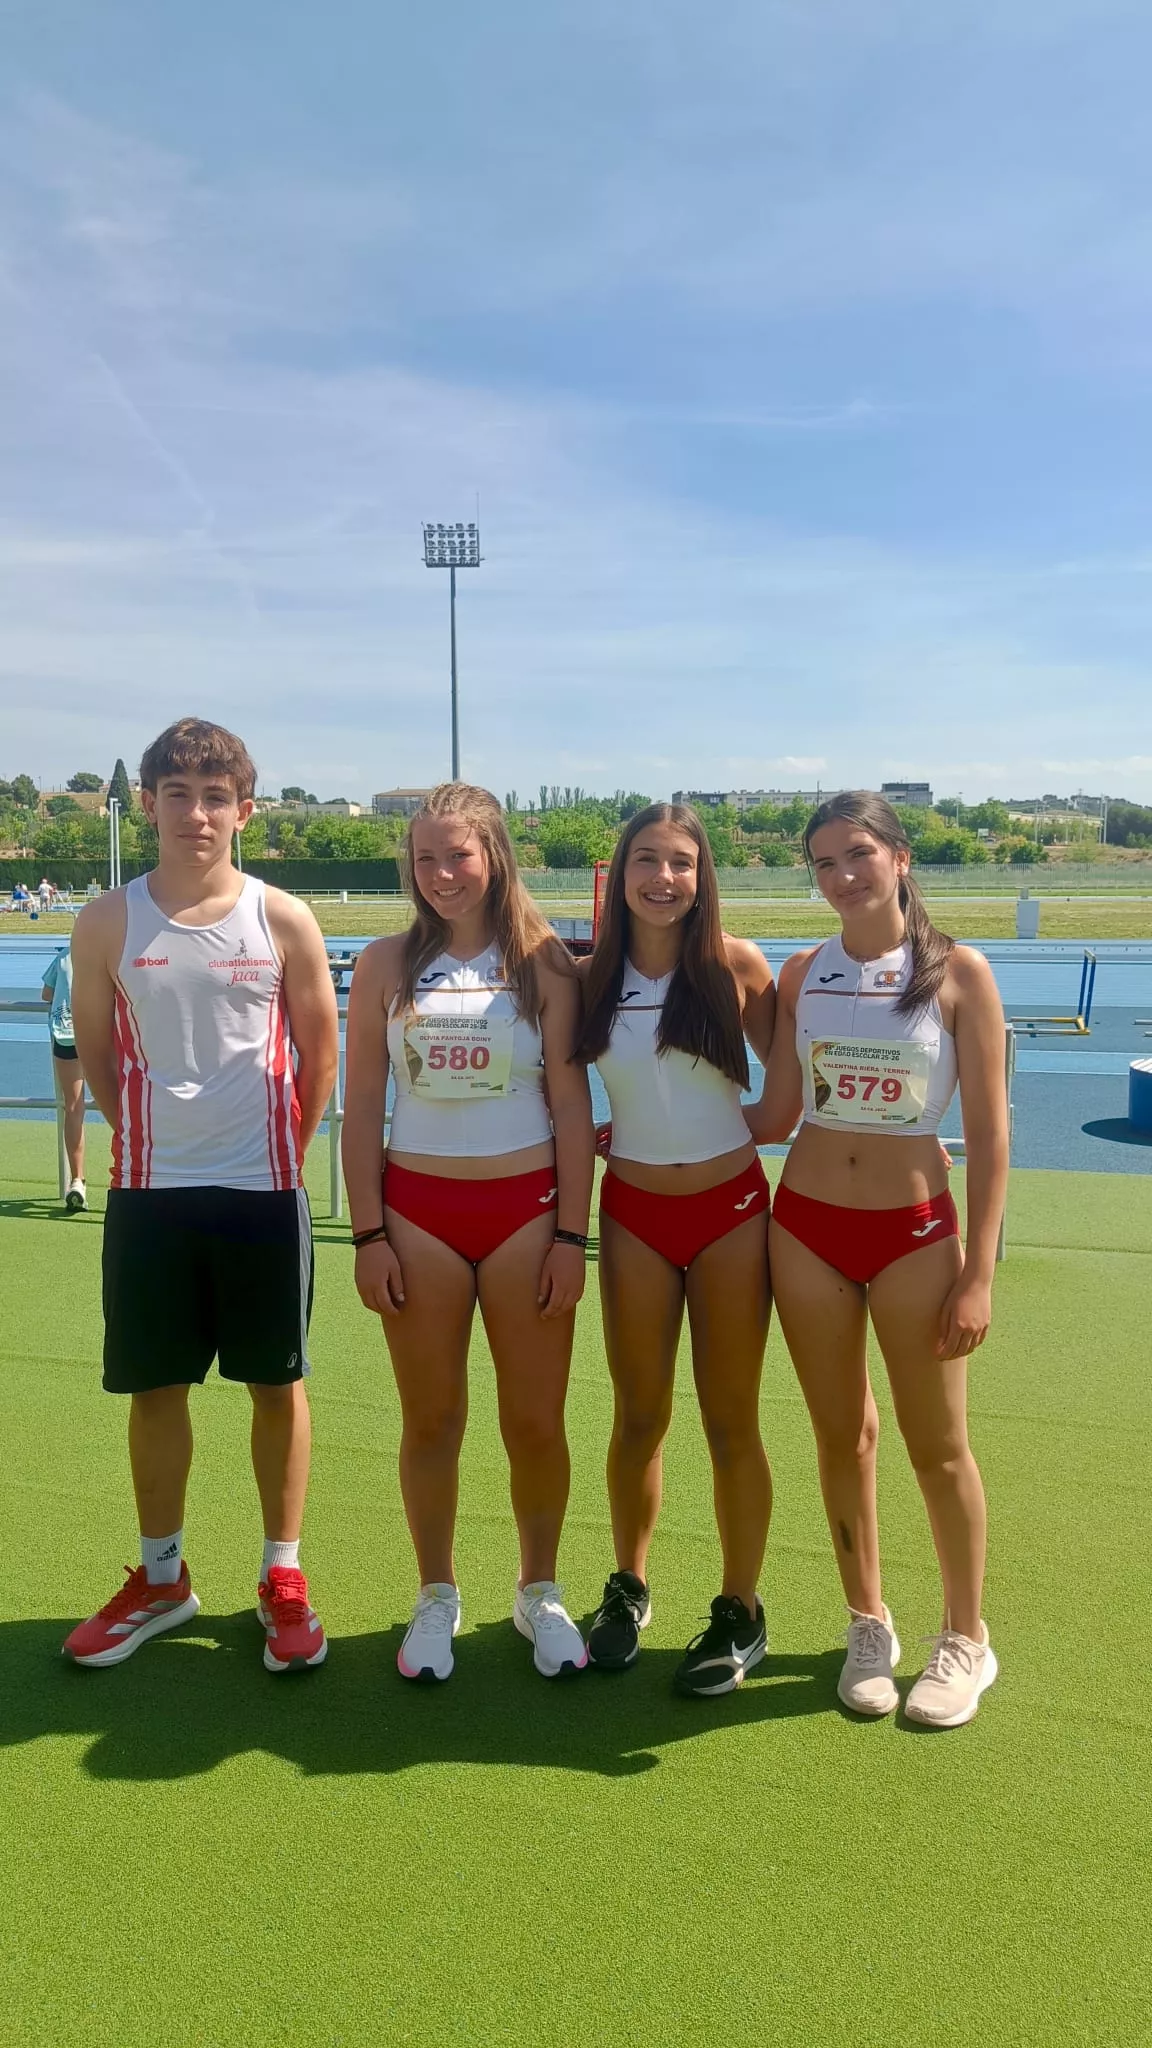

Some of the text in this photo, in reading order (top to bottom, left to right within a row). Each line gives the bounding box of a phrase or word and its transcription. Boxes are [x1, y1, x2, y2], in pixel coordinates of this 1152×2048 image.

[208, 958, 274, 968] clubatletismo
[226, 967, 260, 986] jaca
[428, 1045, 490, 1070] 580
[852, 1051, 880, 1059] ESCOLAR
[860, 1047, 901, 1056] DEPORTIVOS
[822, 1062, 858, 1071] VALENTINA
[883, 1067, 911, 1075] TERREN
[836, 1073, 902, 1103] 579
